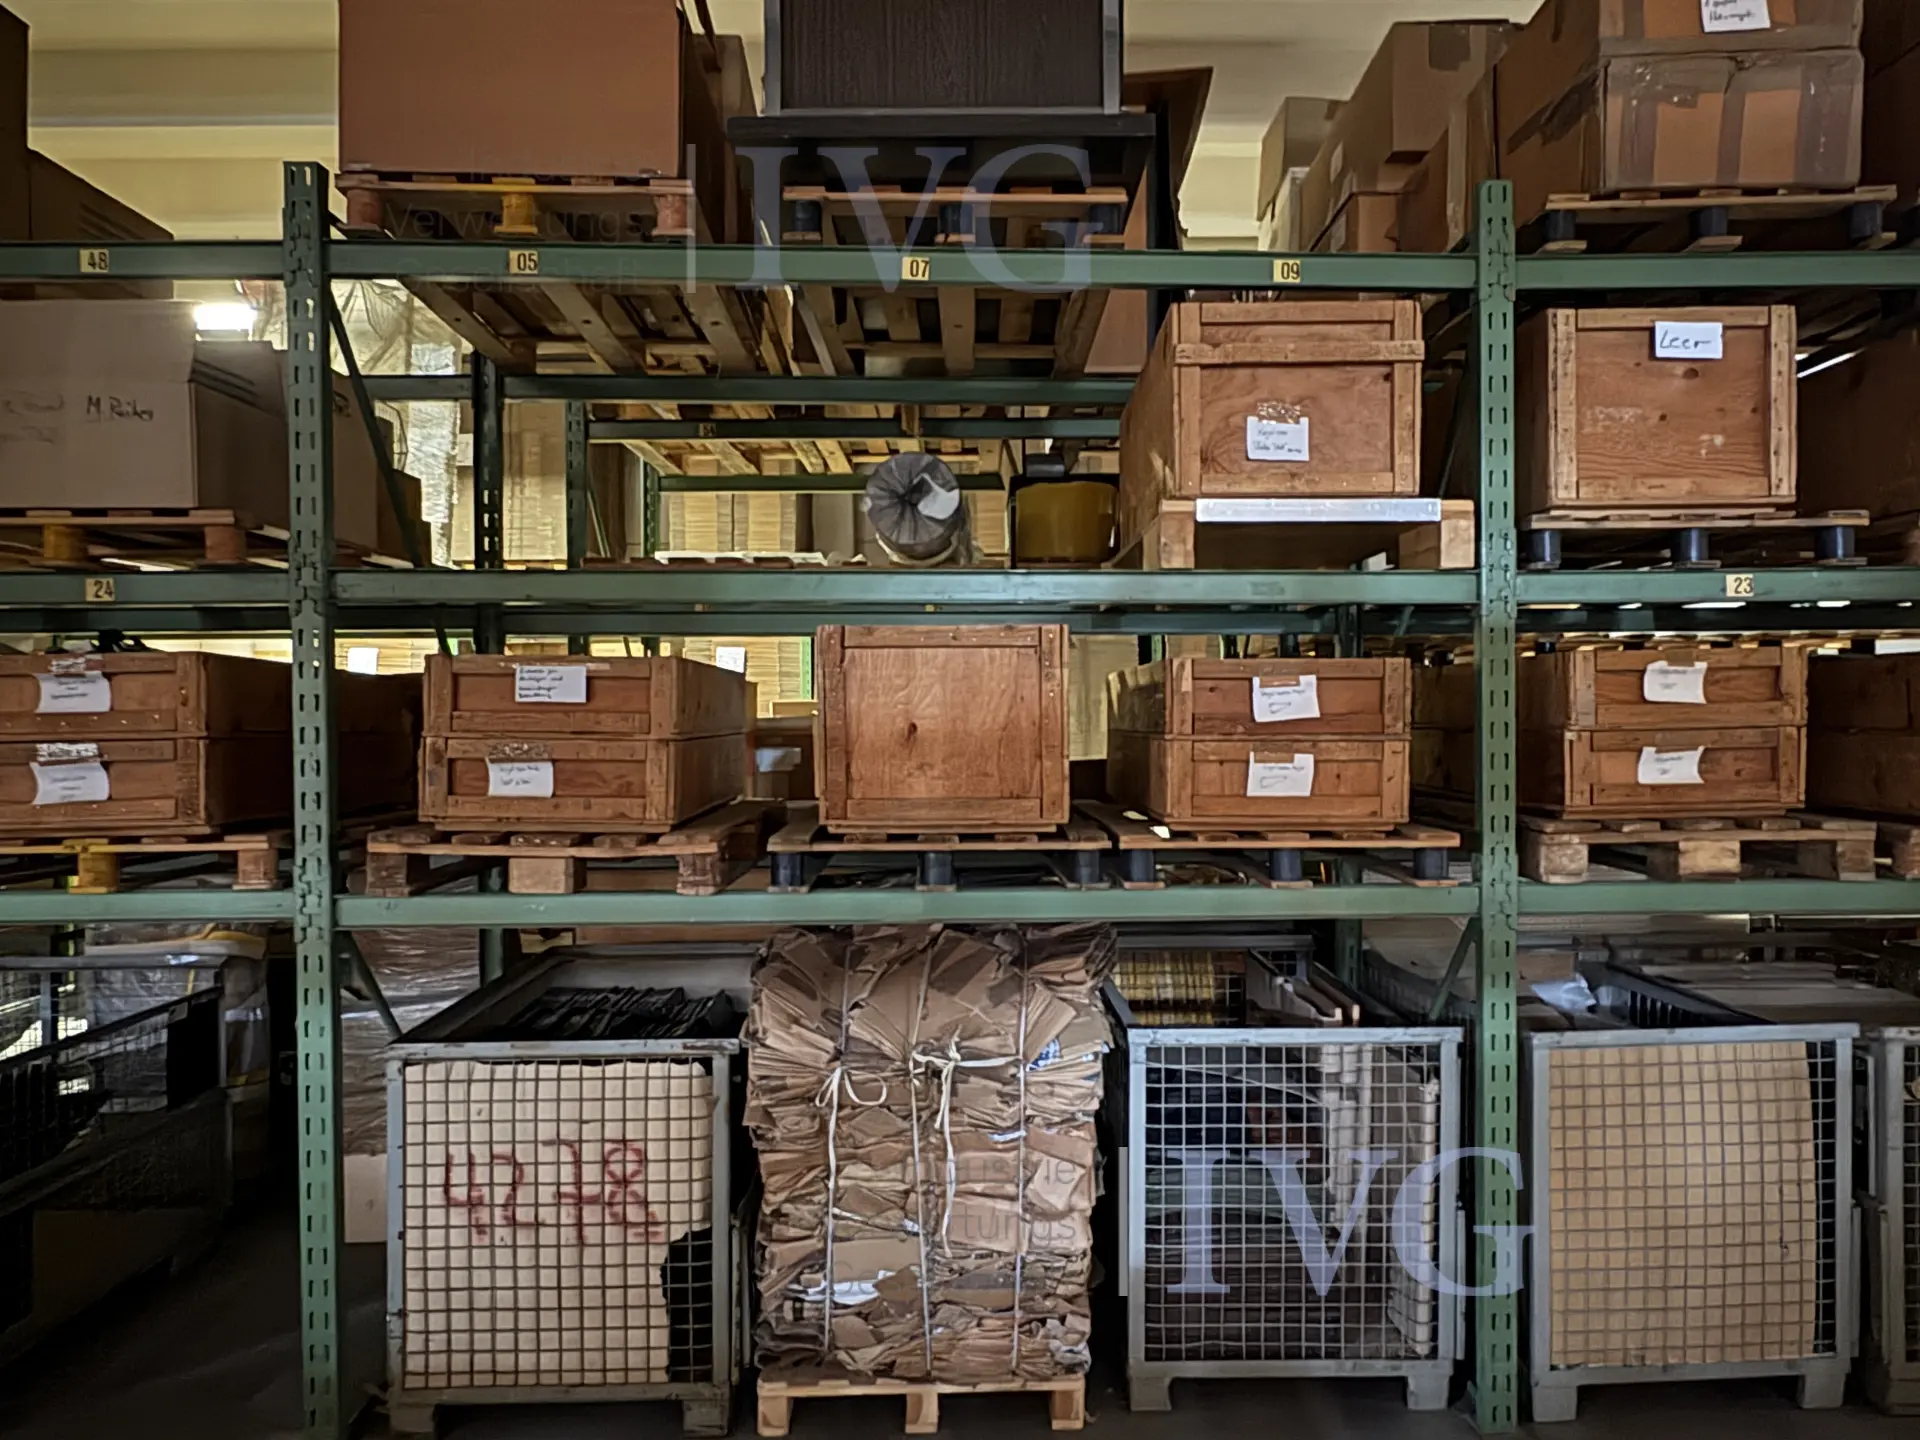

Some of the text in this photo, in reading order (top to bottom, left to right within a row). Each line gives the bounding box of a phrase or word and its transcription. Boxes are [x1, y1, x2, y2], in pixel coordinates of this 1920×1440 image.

[87, 251, 108, 270] 48
[517, 252, 538, 271] 05
[910, 259, 929, 278] 07
[1281, 262, 1300, 280] 09
[1659, 328, 1712, 350] Leer
[93, 579, 114, 599] 24
[1734, 576, 1753, 595] 23
